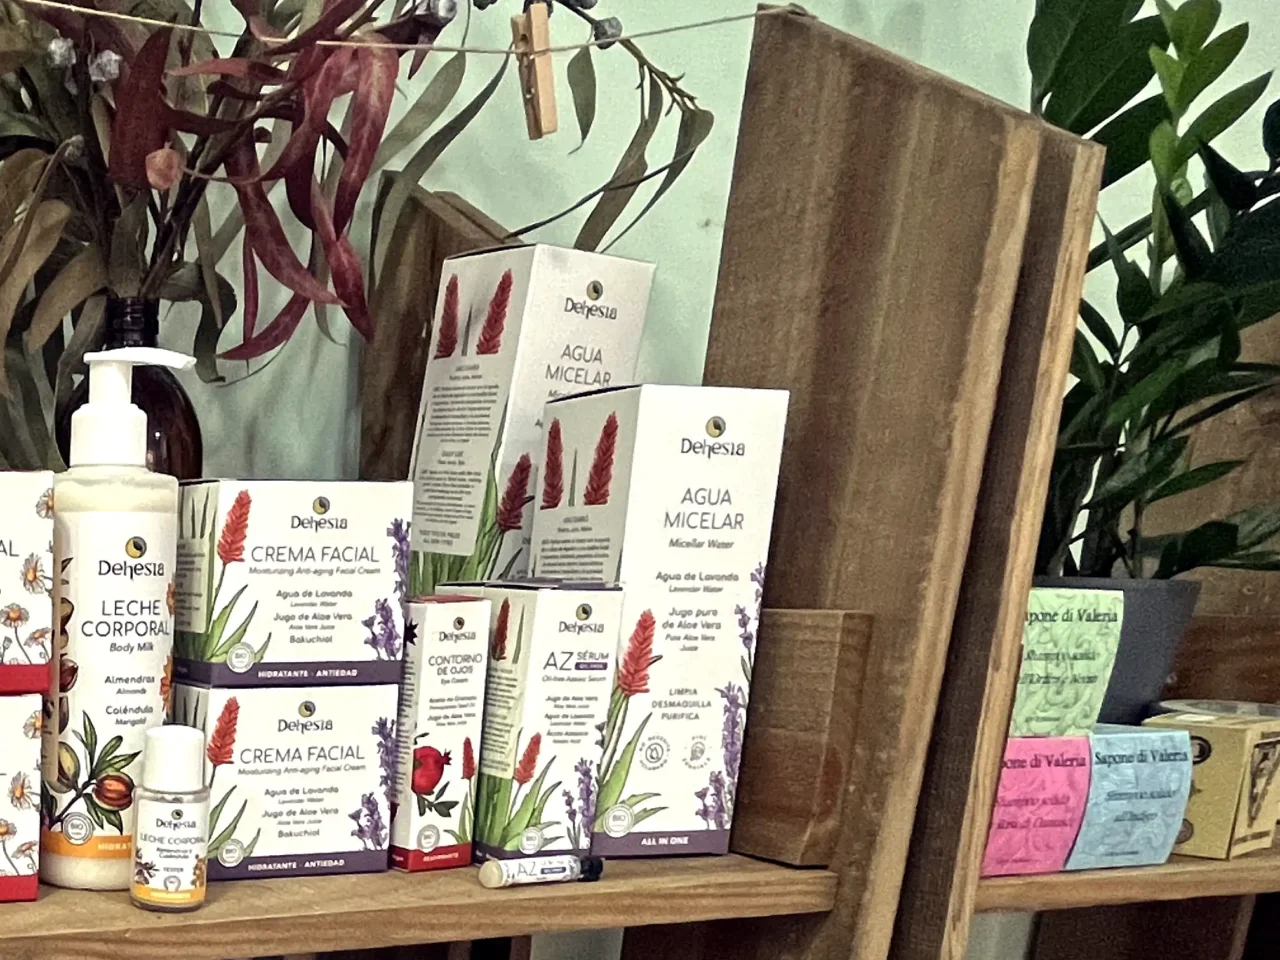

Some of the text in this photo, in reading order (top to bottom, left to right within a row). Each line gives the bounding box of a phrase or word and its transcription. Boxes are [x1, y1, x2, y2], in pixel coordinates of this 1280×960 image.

[561, 345, 603, 364] AGUA
[545, 364, 611, 386] MICELAR
[681, 438, 745, 459] Dehesia
[681, 488, 732, 506] AGUA
[291, 515, 347, 532] Dehesia
[664, 511, 744, 530] MICELAR
[251, 546, 379, 562] CREMA FACIAL
[98, 560, 164, 580] Dehesia
[656, 572, 739, 583] Agua de Lavanda
[276, 590, 299, 599] Agua
[102, 600, 160, 616] LECHE
[668, 608, 718, 619] Jugo puro
[1026, 610, 1118, 625] pone di Valeria
[82, 620, 170, 637] CORPORAL
[110, 643, 134, 654] Body
[428, 654, 482, 666] CONTORNO
[543, 650, 609, 670] AZ SÉRUM
[437, 666, 473, 674] DE OJOS
[106, 706, 153, 714] Caléndula
[278, 719, 333, 734] Dehesia
[240, 746, 364, 764] CREMA FACIAL
[1030, 754, 1041, 766] di
[1044, 753, 1086, 766] Valeria
[1094, 750, 1189, 768] Sapone di Valeria
[641, 837, 689, 845] ALL IN ONE
